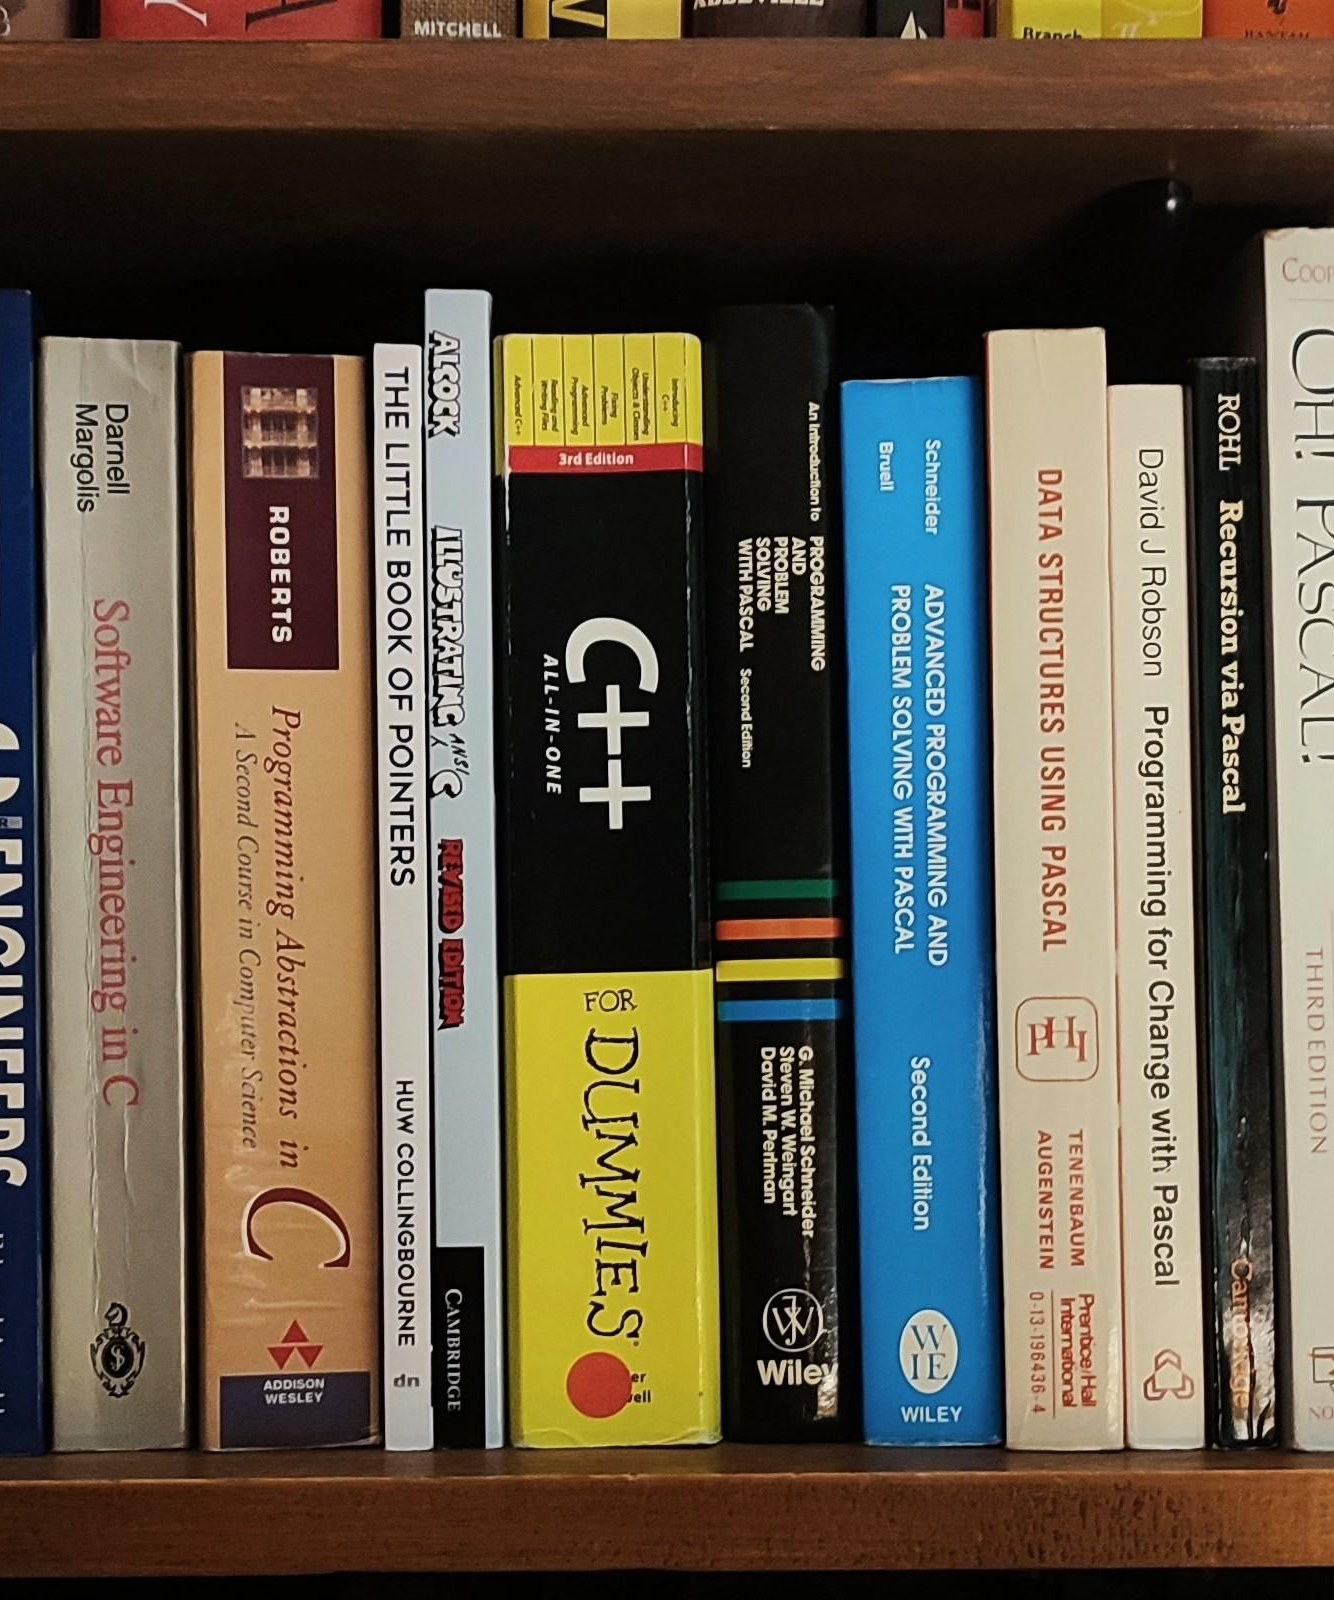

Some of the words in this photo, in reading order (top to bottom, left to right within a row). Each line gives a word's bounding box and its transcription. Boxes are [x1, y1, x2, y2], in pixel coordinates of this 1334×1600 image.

[414, 20, 502, 39] MITCHELL
[384, 369, 412, 429] THE
[807, 402, 821, 422] An
[1217, 393, 1242, 472] ROHL
[105, 404, 130, 495] Darnell
[558, 452, 586, 465] 3rd
[589, 451, 635, 466] Edition
[808, 424, 822, 504] Introduction
[878, 442, 894, 491] Bruell
[924, 439, 942, 535] Schneider
[385, 442, 413, 546] LITTLE
[809, 507, 821, 521] to
[1038, 469, 1063, 542] DATA
[269, 506, 293, 644] ROBERTS
[738, 538, 753, 582] WITH
[756, 537, 771, 612] SOLVING
[773, 537, 789, 614] PROBLEM
[792, 537, 806, 575] AND
[387, 561, 414, 654] BOOK
[738, 585, 754, 653] PASCAL
[809, 536, 826, 672] PROGRAMMING
[1038, 552, 1066, 734] STRUCTURES
[92, 600, 133, 767] Software
[388, 667, 415, 712] OF
[739, 668, 754, 721] Second
[543, 654, 563, 795] ALL-IN-ONE
[740, 723, 754, 768] Edition
[388, 724, 417, 887] POINTERS
[1040, 746, 1067, 832] USING
[89, 779, 138, 1013] Engineering
[1041, 846, 1067, 953] PASCAL
[1303, 946, 1327, 1033] THIRD
[101, 1028, 139, 1063] in
[779, 1046, 795, 1107] Steven
[101, 1075, 139, 1108] C
[780, 1110, 796, 1132] W.
[910, 1056, 932, 1148] Second
[1306, 1039, 1330, 1155] EDITION
[779, 1135, 798, 1217] Weingart
[912, 1155, 933, 1231] Edition
[1037, 1130, 1055, 1270] AUGENSTEIN
[1068, 1129, 1086, 1268] TENENBAUM
[263, 1380, 326, 1391] ADDISON
[445, 1289, 464, 1412] CAMBRIDGE
[265, 1392, 324, 1405] WESLEY
[899, 1405, 963, 1424] WILEY
